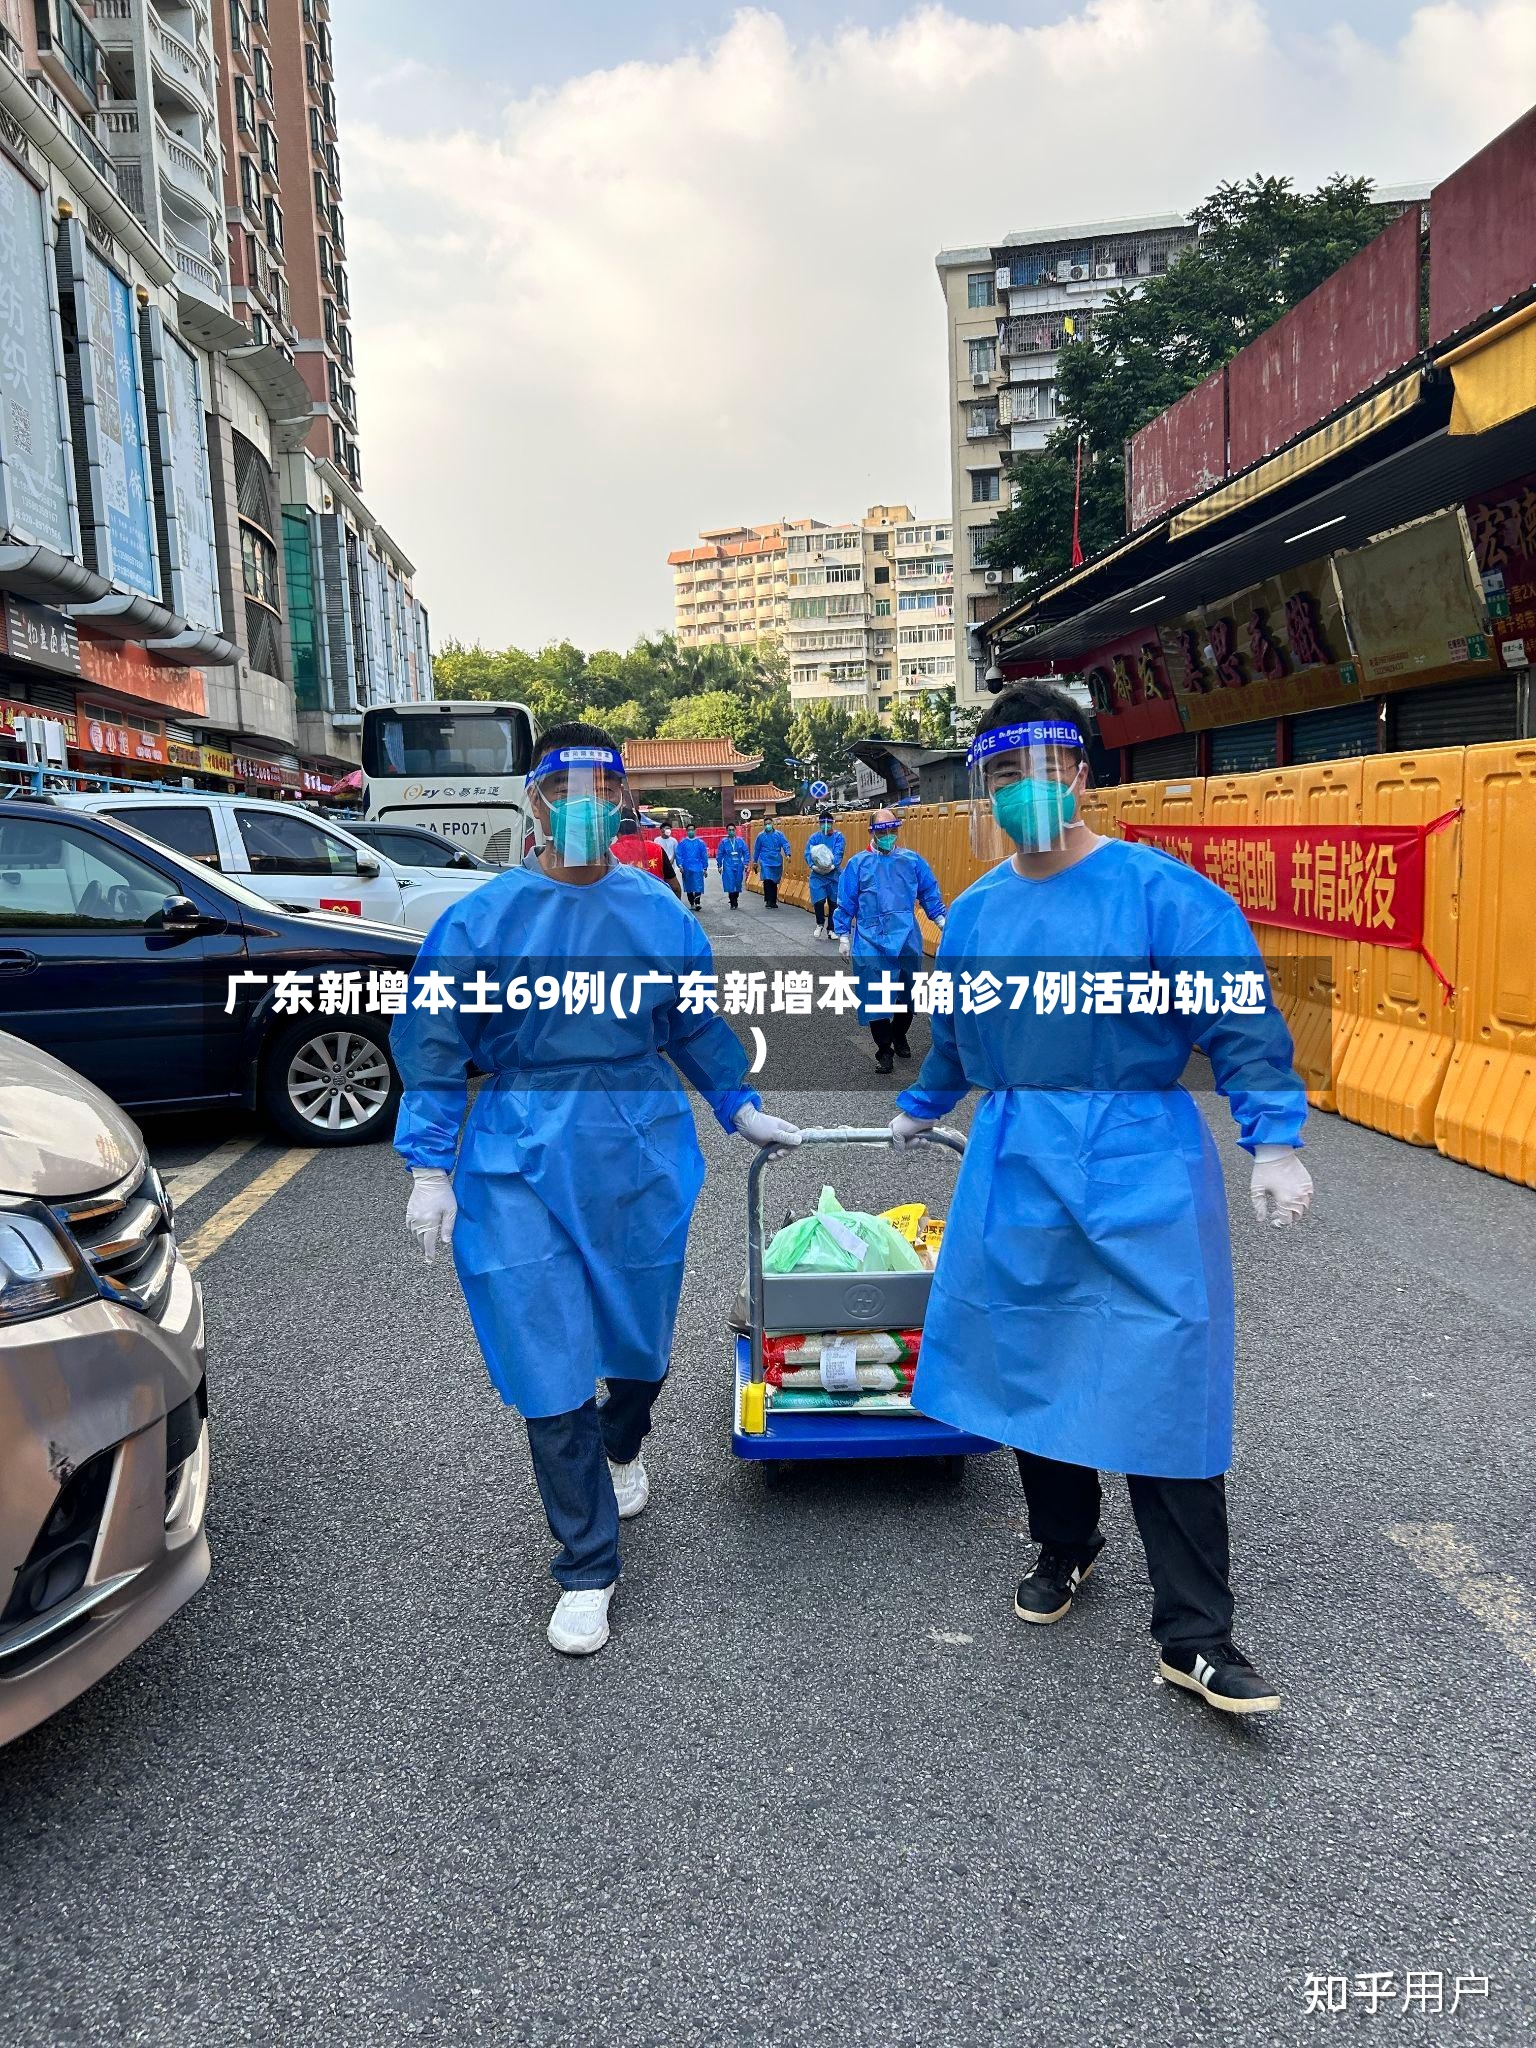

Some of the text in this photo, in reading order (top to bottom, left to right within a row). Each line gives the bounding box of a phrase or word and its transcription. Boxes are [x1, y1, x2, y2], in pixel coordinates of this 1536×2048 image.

[1475, 643, 1482, 656] 3
[1345, 671, 1352, 684] 2
[973, 735, 997, 756] FACE
[1033, 726, 1078, 742] SHIELD
[442, 822, 487, 836] FP071
[1291, 839, 1398, 930] 并肩战役
